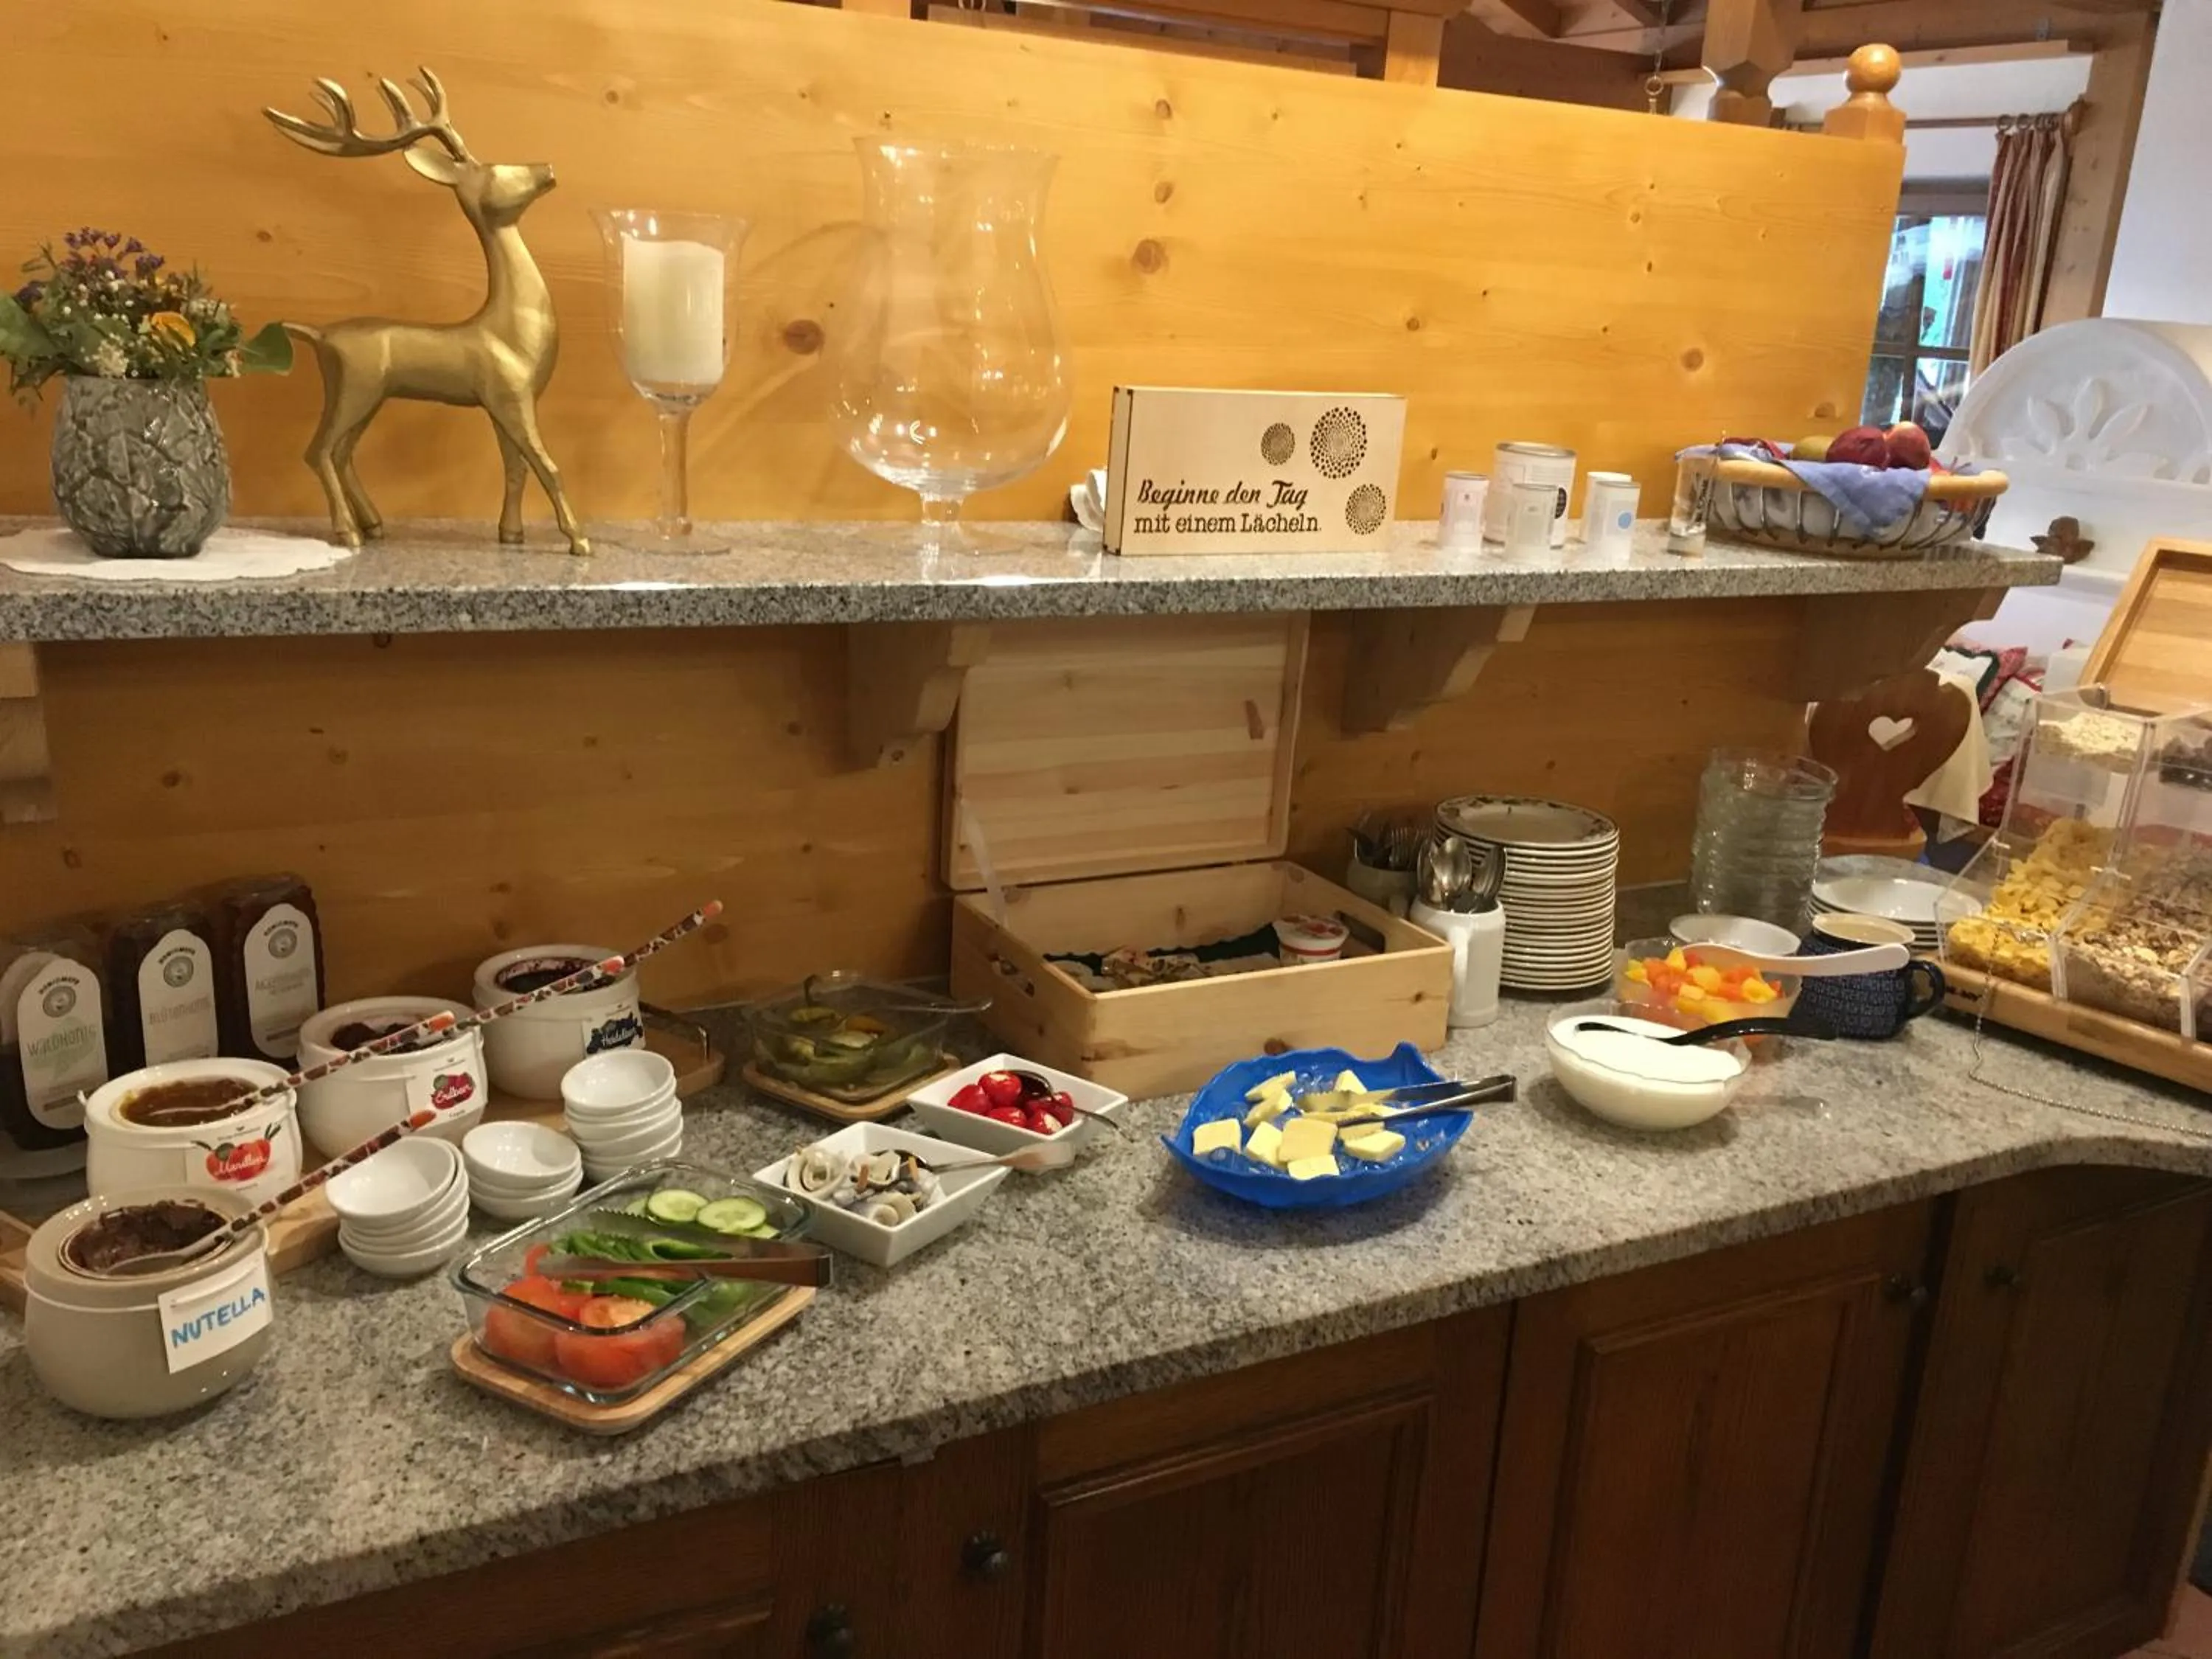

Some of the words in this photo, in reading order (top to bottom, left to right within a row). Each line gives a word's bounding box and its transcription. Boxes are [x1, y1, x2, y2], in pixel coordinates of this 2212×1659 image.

[1137, 479, 1220, 510] Beginne
[1222, 481, 1262, 504] den
[1266, 480, 1309, 510] Tag
[1134, 513, 1171, 533] mit
[1175, 513, 1237, 533] einem
[171, 1287, 266, 1349] NUTELLA
